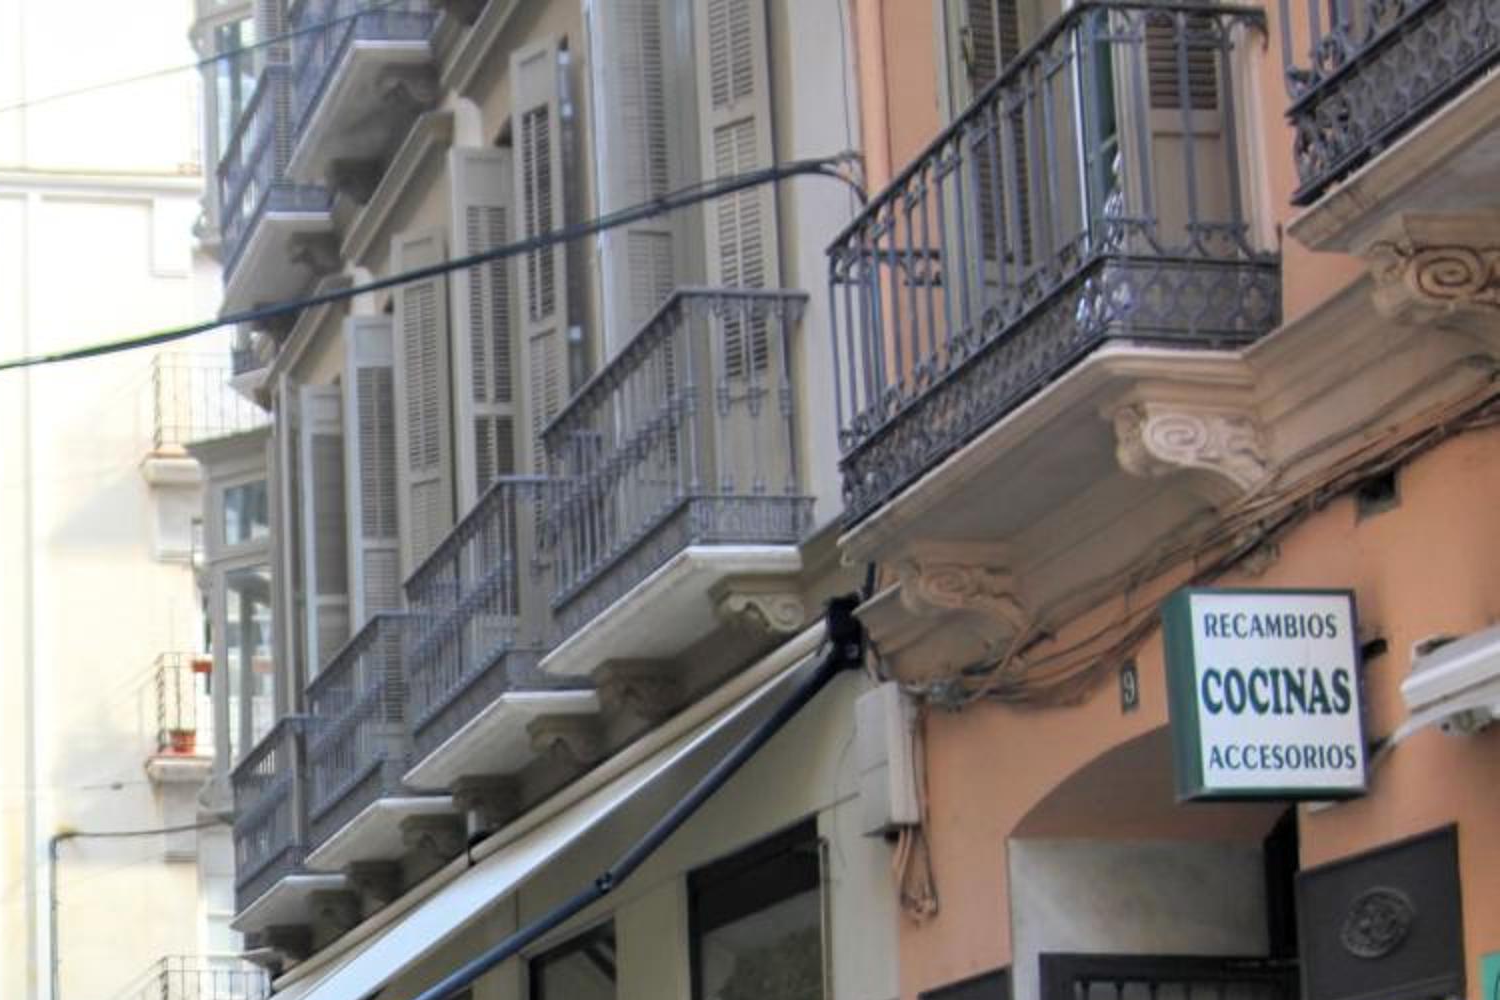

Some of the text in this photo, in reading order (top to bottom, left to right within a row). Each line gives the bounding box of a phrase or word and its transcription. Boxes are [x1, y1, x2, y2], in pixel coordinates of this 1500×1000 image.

[1204, 612, 1338, 639] RECAMBIOS
[1123, 669, 1136, 705] 9
[1201, 667, 1351, 715] COCINAS
[1208, 744, 1357, 770] ACCESORIOS
